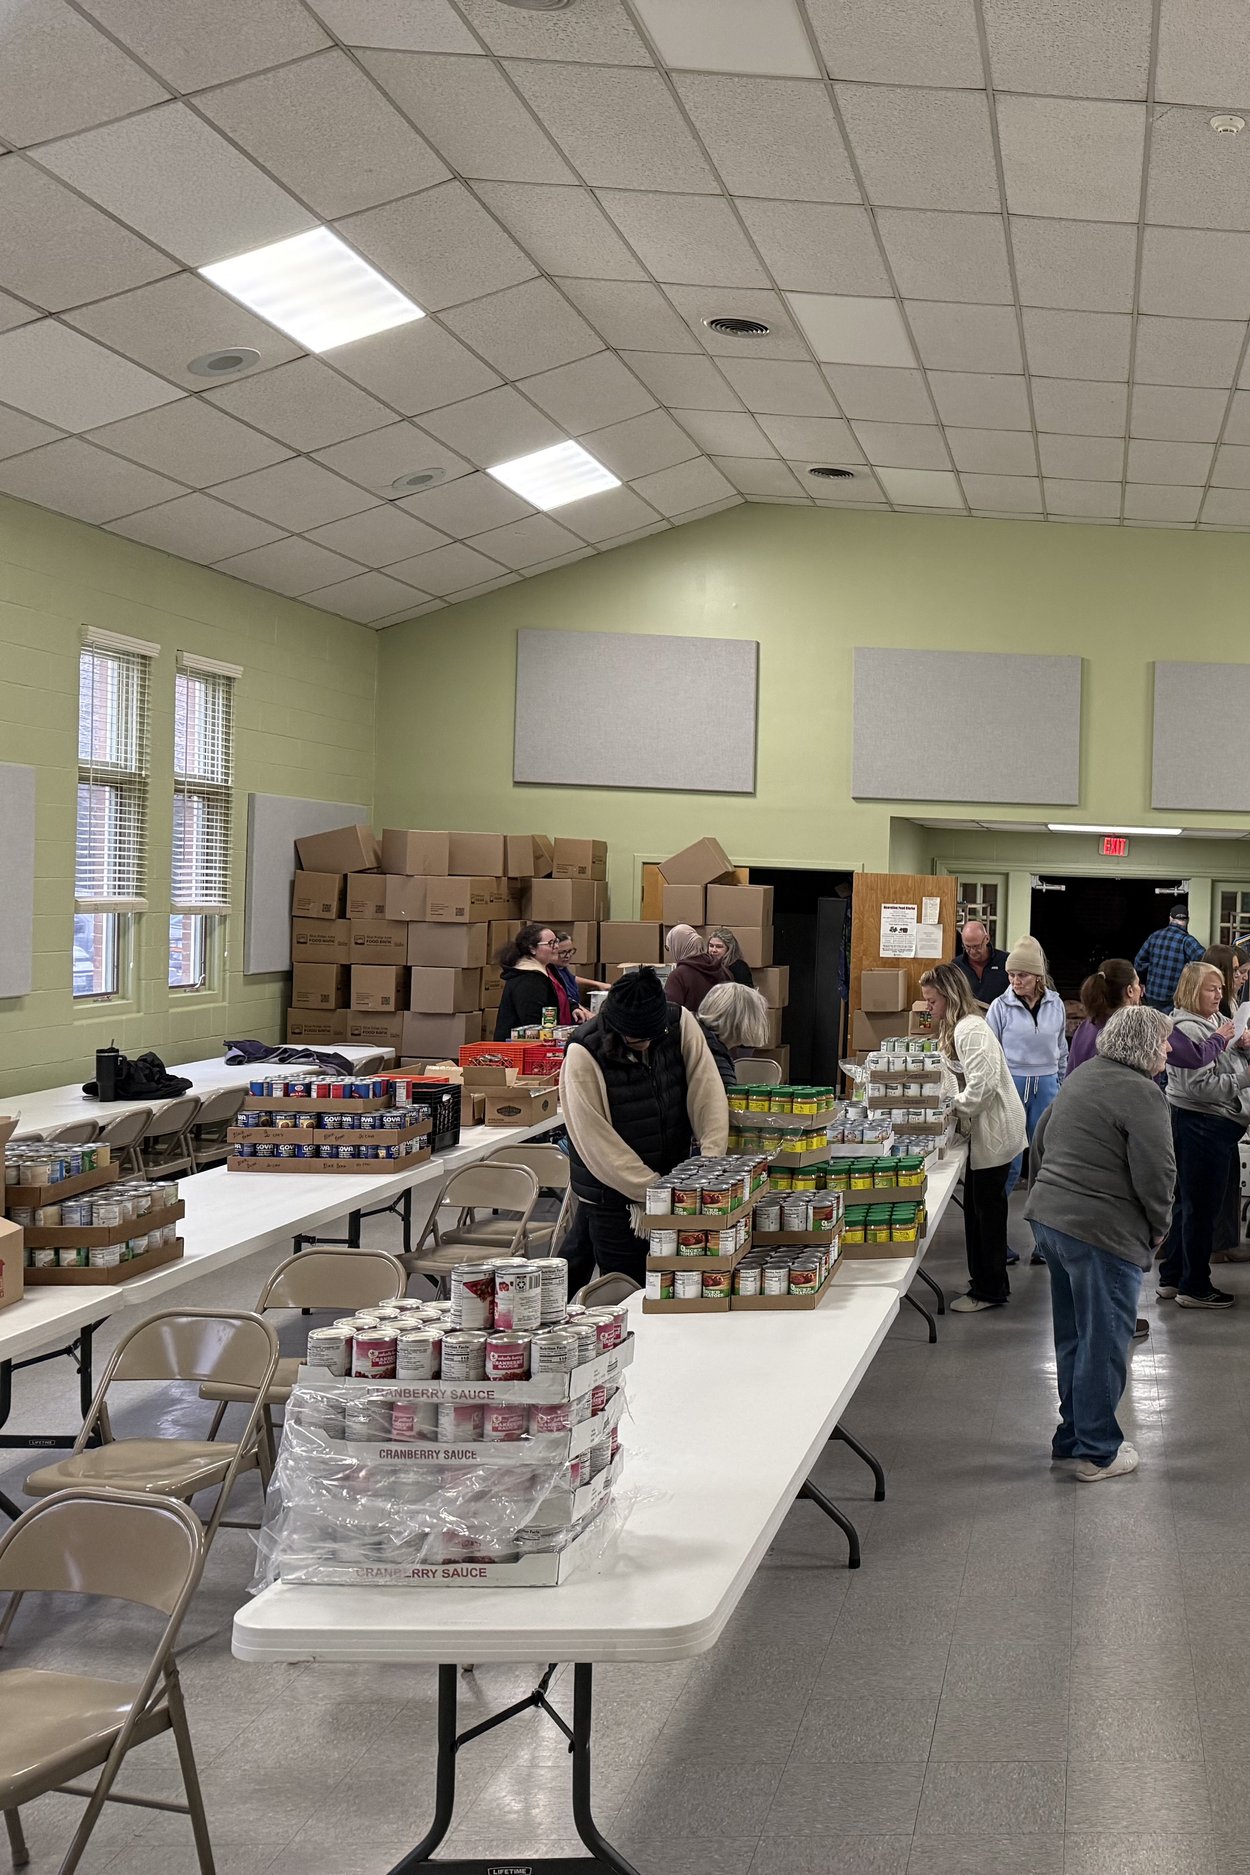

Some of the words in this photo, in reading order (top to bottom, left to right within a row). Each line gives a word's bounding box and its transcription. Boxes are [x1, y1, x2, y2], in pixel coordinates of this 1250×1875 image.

[1104, 837, 1126, 856] EXIT
[450, 1389, 495, 1400] SAUCE
[379, 1449, 440, 1460] CRANBERRY
[443, 1450, 477, 1460] SAUCE
[356, 1567, 438, 1578] CRANBRRY
[441, 1567, 487, 1578] SAUCE
